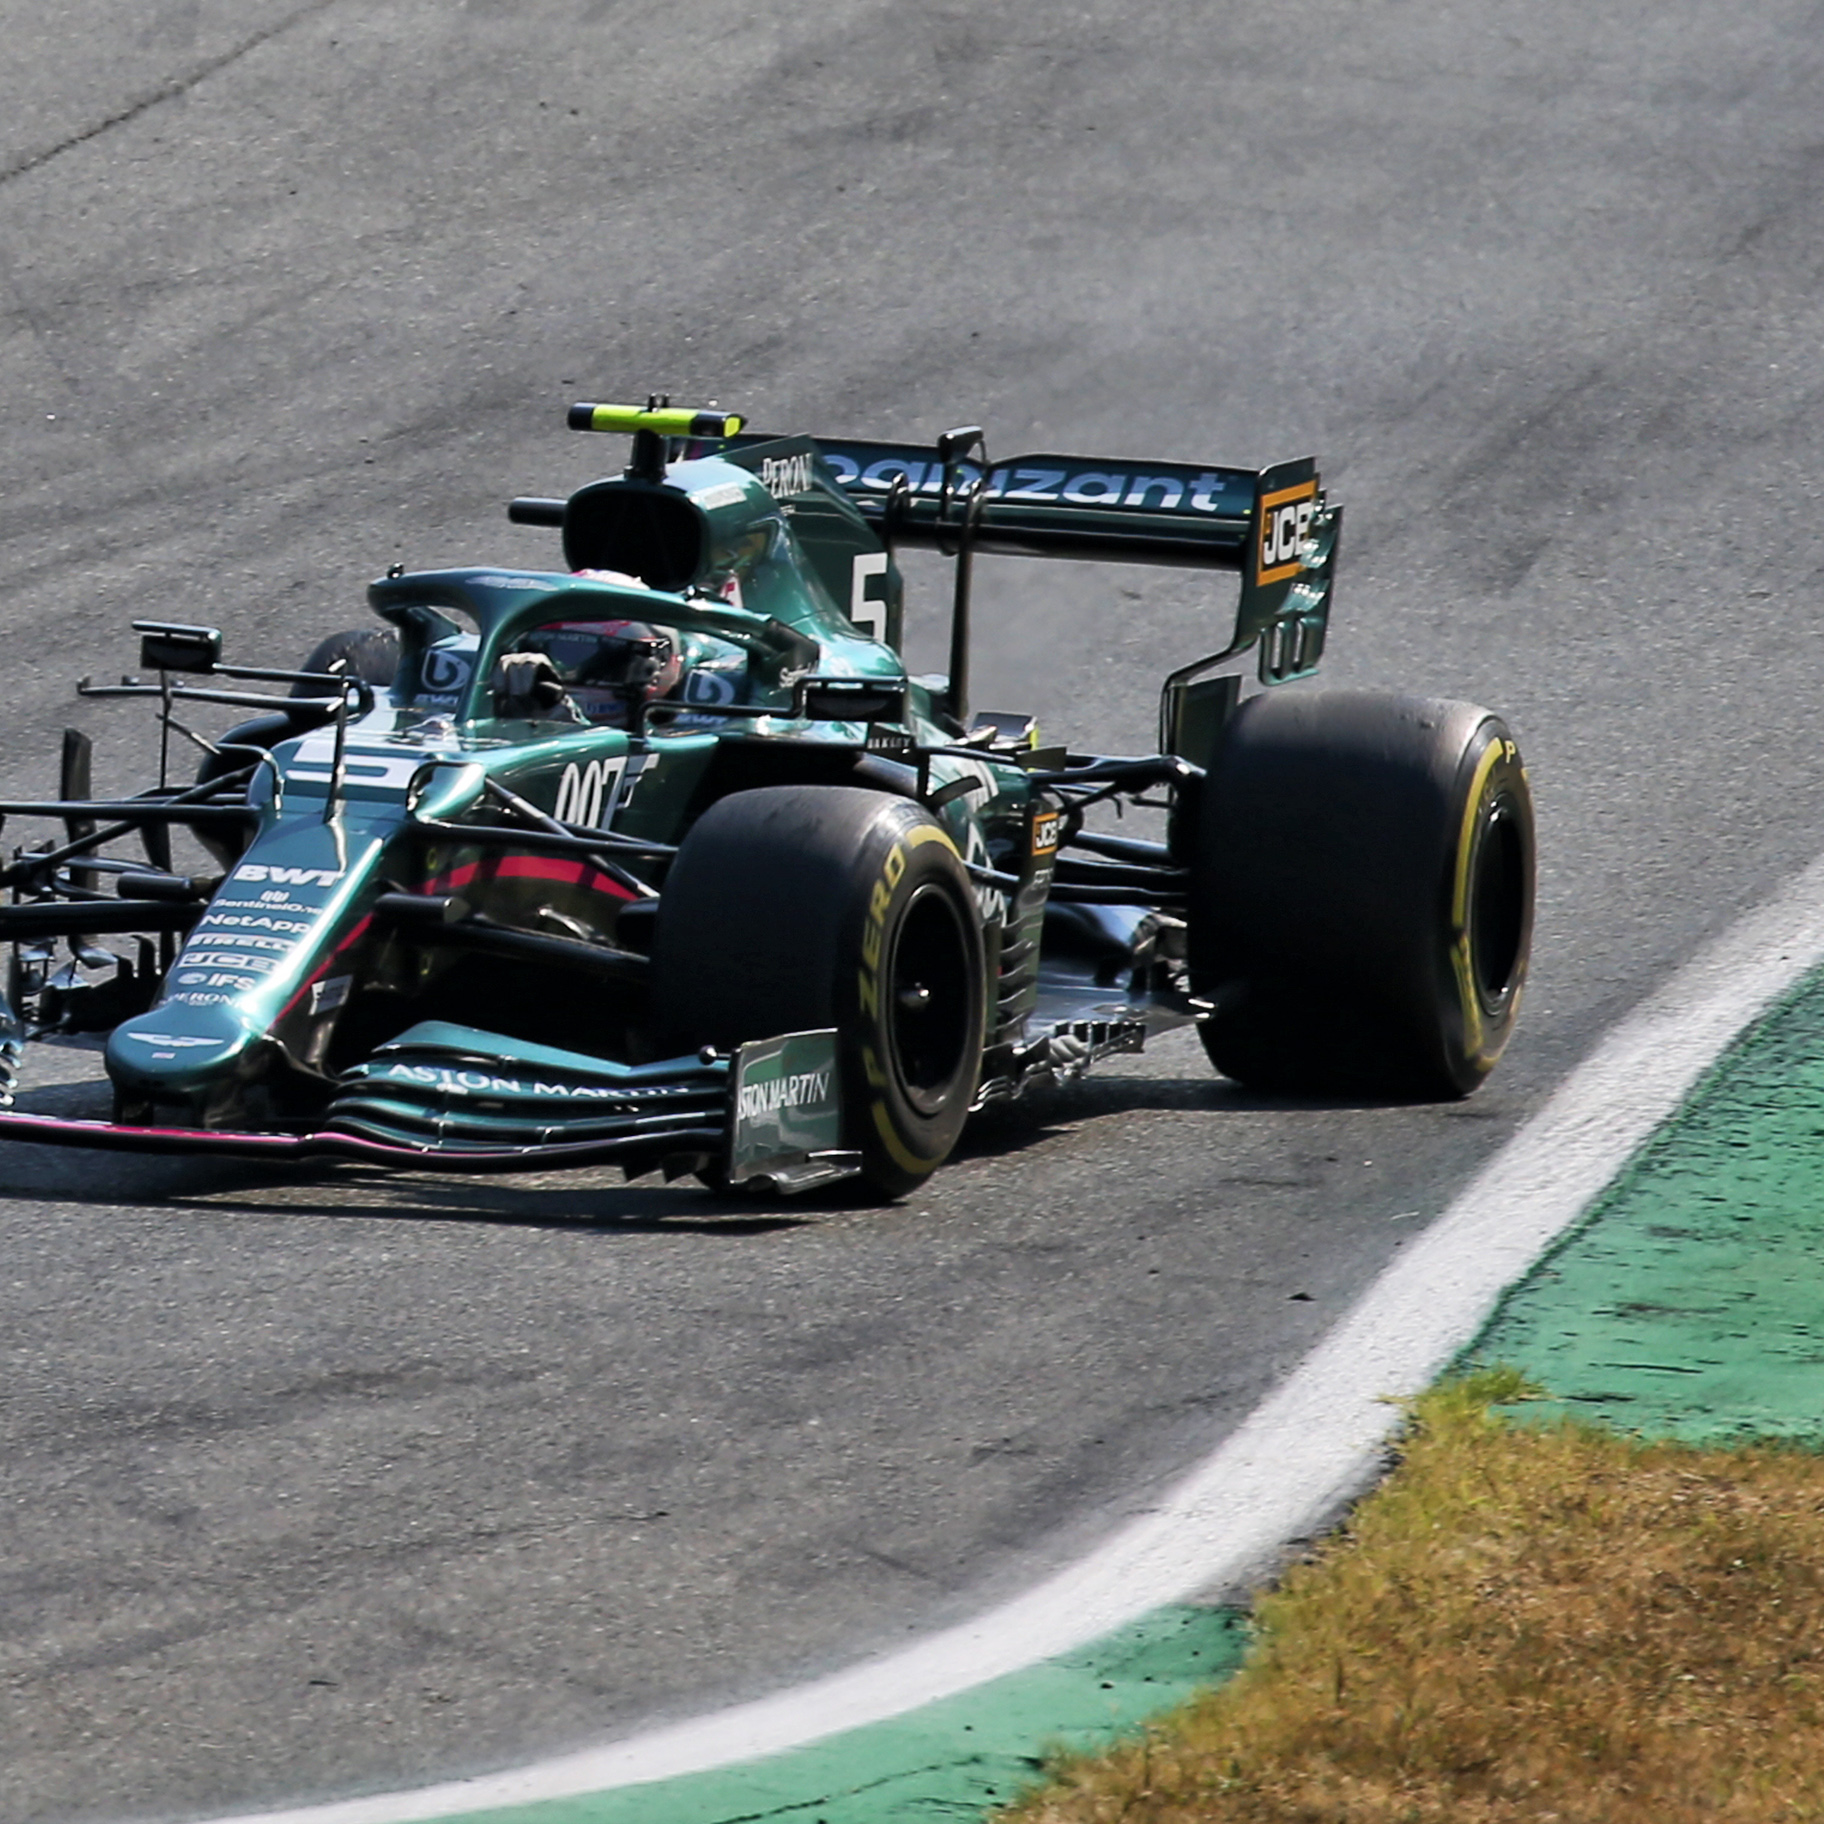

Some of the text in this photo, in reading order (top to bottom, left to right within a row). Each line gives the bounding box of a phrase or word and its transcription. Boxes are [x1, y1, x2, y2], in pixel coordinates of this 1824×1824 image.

[1263, 501, 1313, 565] JCB
[852, 552, 888, 644] 5
[1036, 820, 1057, 848] JCB
[233, 863, 346, 887] BWT
[202, 913, 311, 935] NetApp
[858, 841, 906, 1019] ZERO
[208, 973, 257, 993] IFS
[387, 1062, 522, 1093] ASTON
